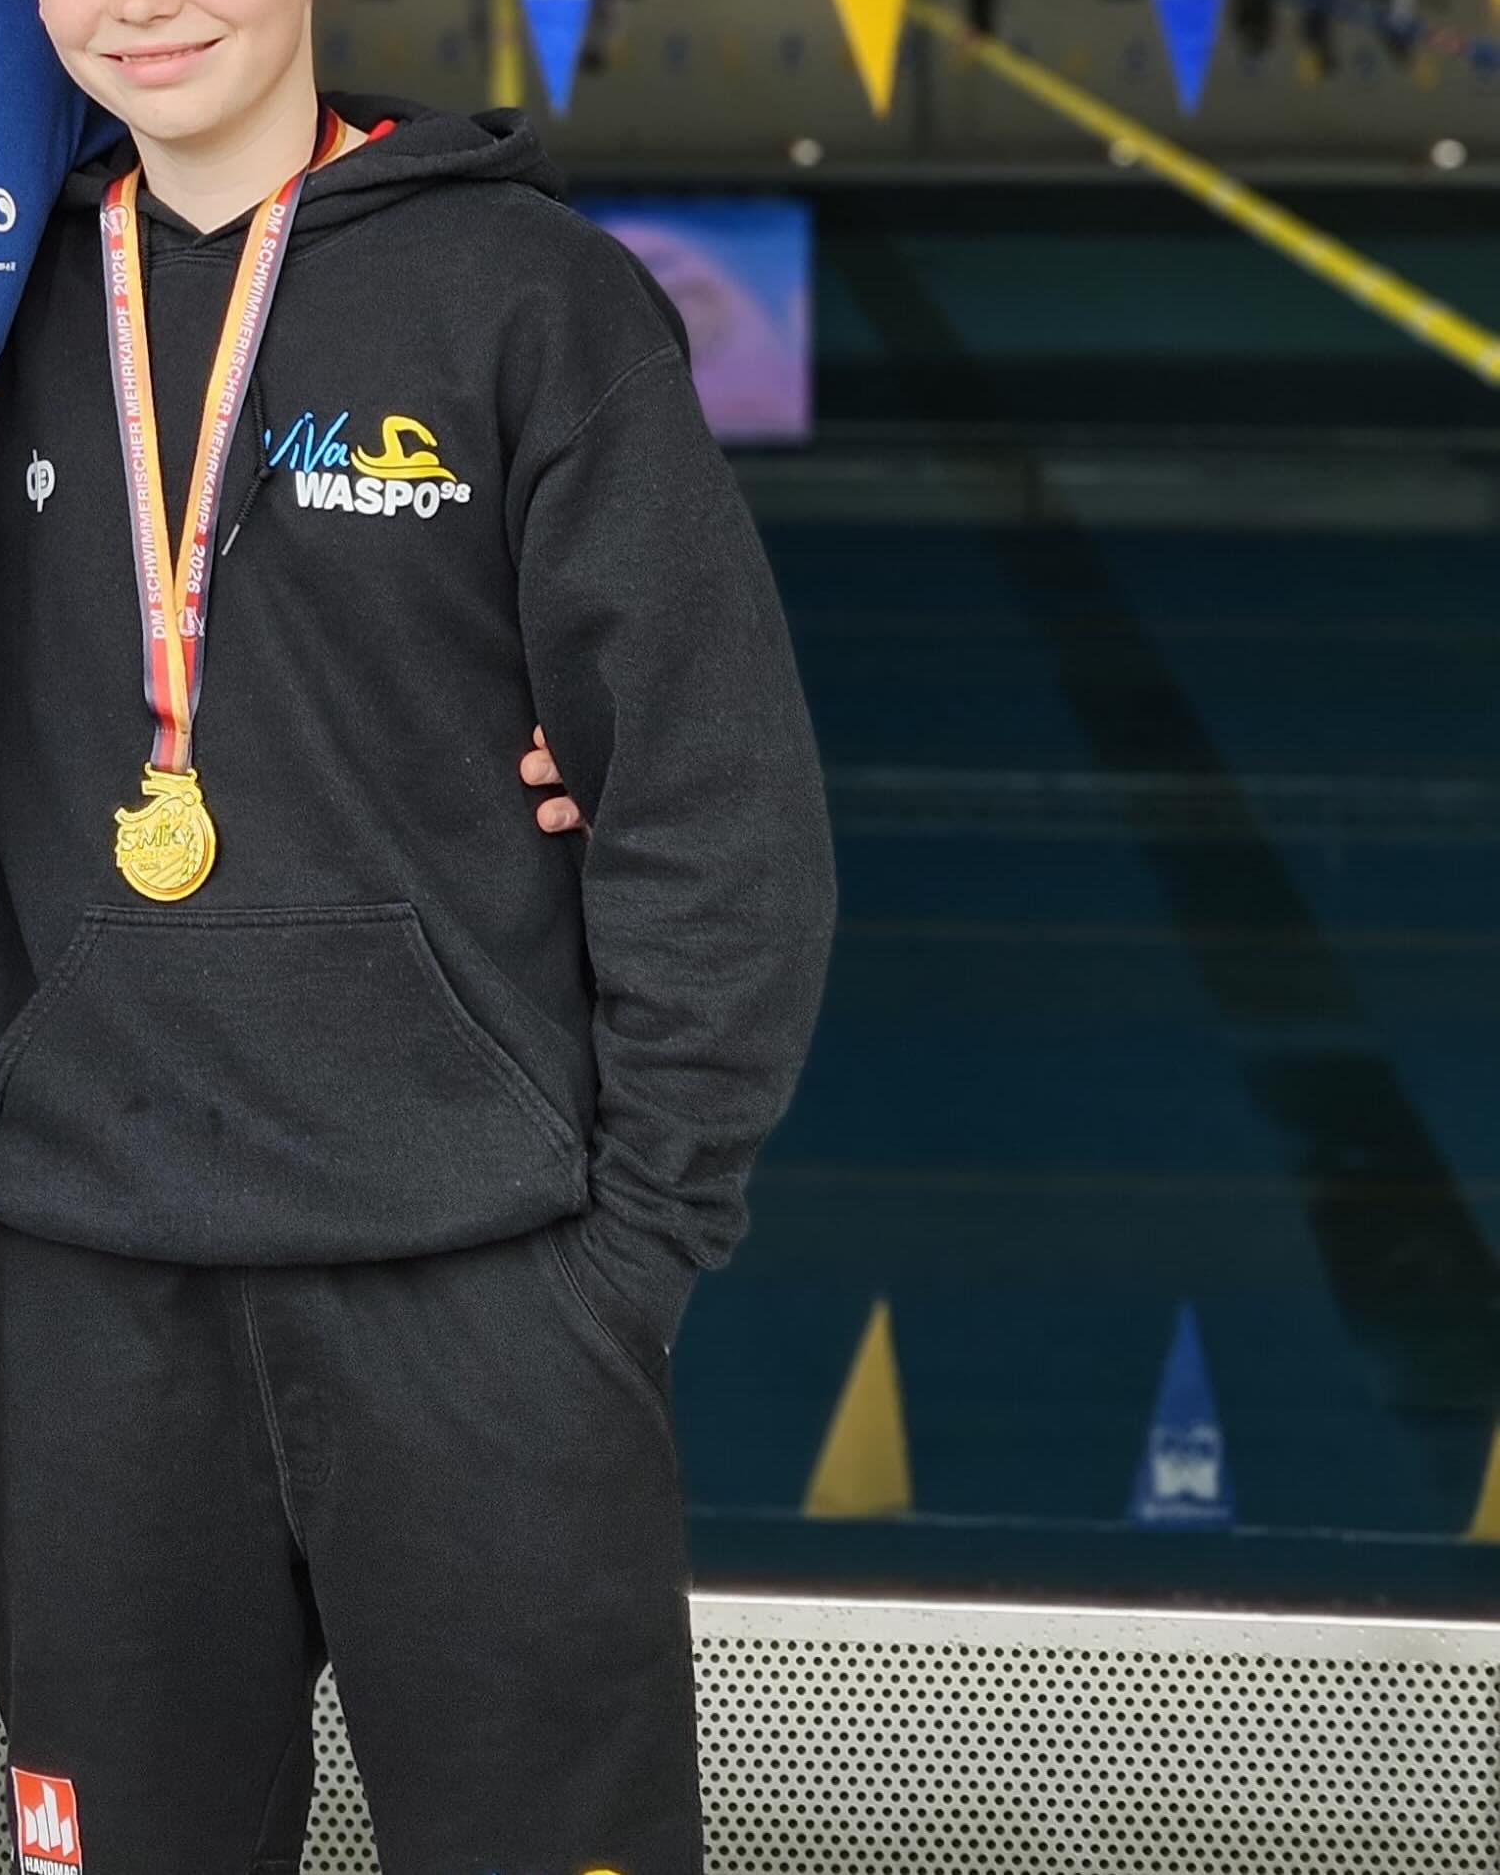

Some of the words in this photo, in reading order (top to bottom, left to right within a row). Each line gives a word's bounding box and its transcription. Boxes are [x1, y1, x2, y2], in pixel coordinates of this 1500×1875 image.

[267, 203, 285, 233] DM
[111, 249, 128, 296] 2026
[117, 305, 140, 416] MEHRKAMPF
[218, 236, 277, 415] SCHWIMMERISCHER
[128, 422, 162, 602] SCHWIMMERISCHER
[195, 421, 229, 534] MEHRKAMPF
[187, 542, 206, 594] 2026
[152, 609, 166, 638] DM
